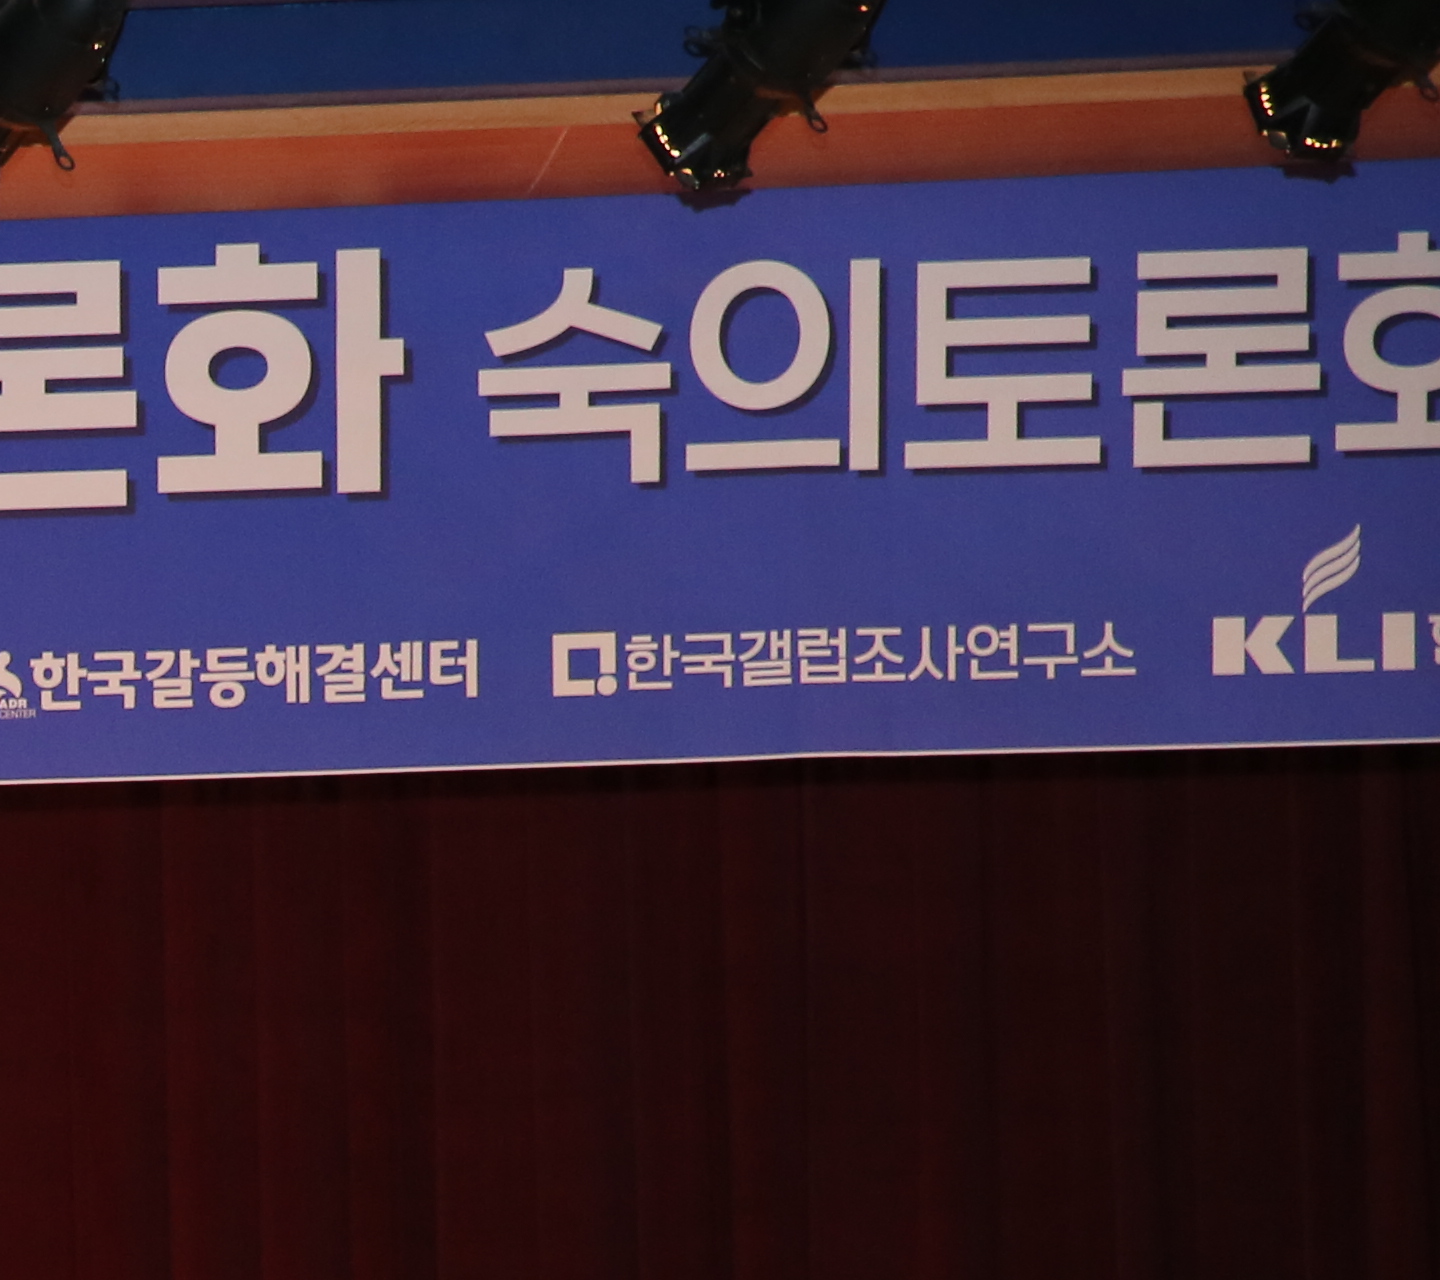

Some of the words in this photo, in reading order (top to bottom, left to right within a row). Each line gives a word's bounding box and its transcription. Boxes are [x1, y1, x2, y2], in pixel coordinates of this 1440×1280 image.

[30, 640, 478, 711] 한국갈등해결센터
[624, 621, 1137, 691] 한국갤럽조사연구소
[1212, 611, 1416, 676] KLI
